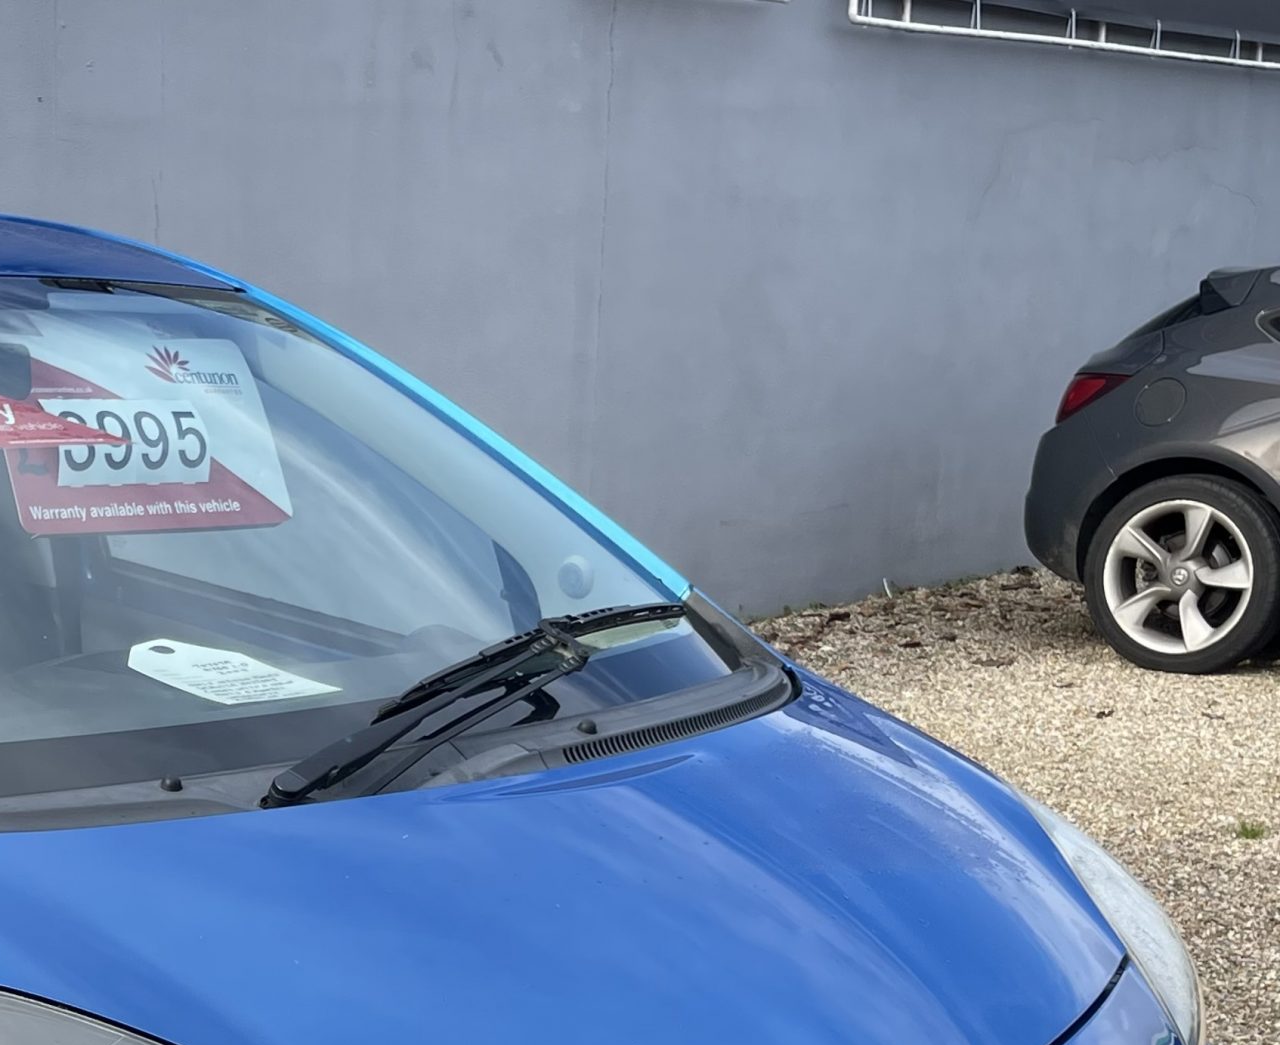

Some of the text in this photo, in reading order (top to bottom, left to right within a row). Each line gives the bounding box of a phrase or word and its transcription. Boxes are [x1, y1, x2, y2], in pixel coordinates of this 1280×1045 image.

[174, 371, 239, 386] centurion
[29, 498, 241, 522] Warranty available with this vehicle
